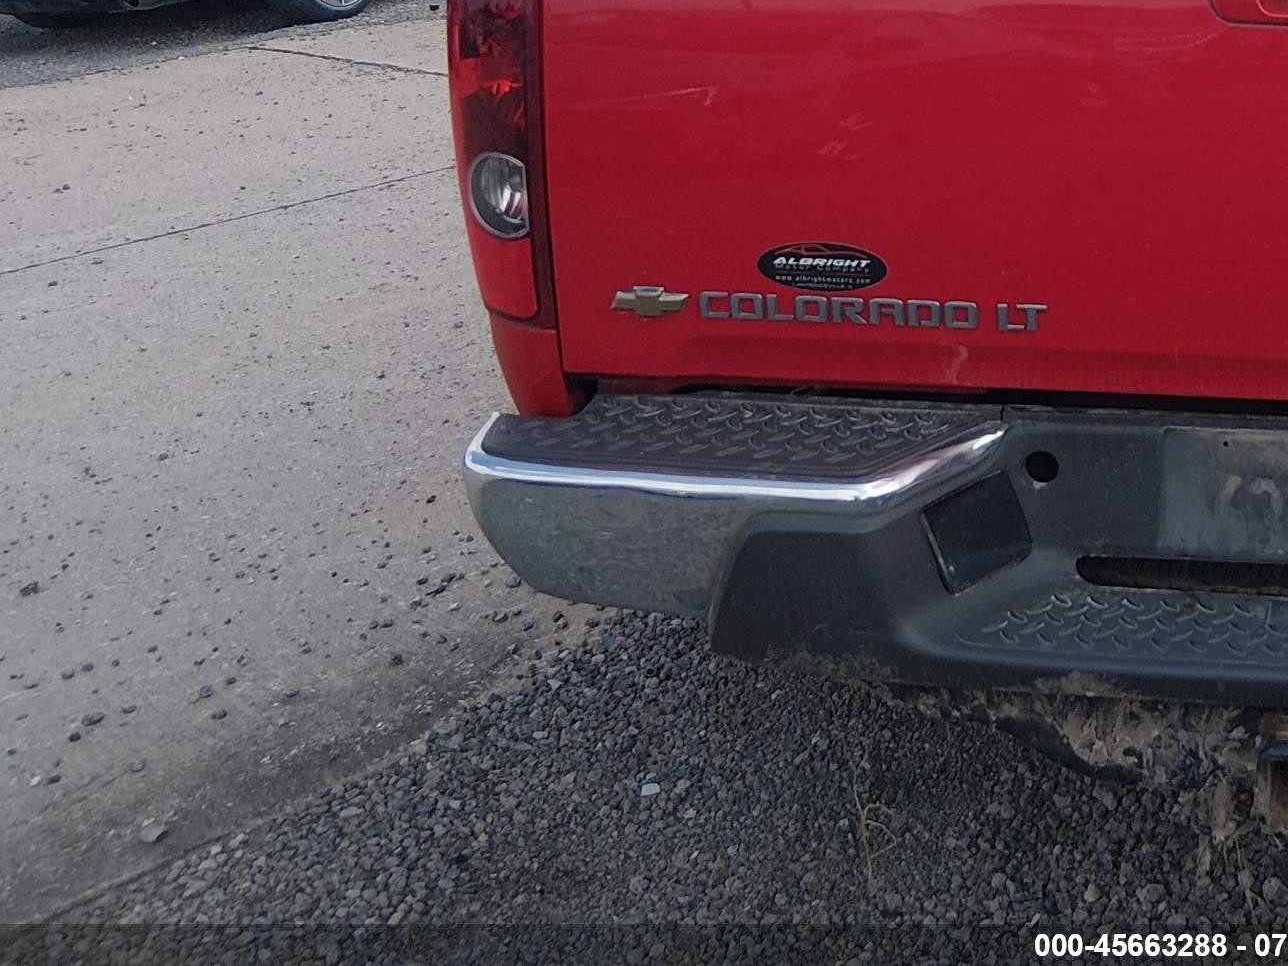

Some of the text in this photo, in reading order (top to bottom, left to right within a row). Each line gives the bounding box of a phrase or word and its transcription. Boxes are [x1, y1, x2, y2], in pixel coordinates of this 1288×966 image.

[773, 256, 871, 267] ALBRIGHT
[700, 290, 1048, 331] COLORADO LT
